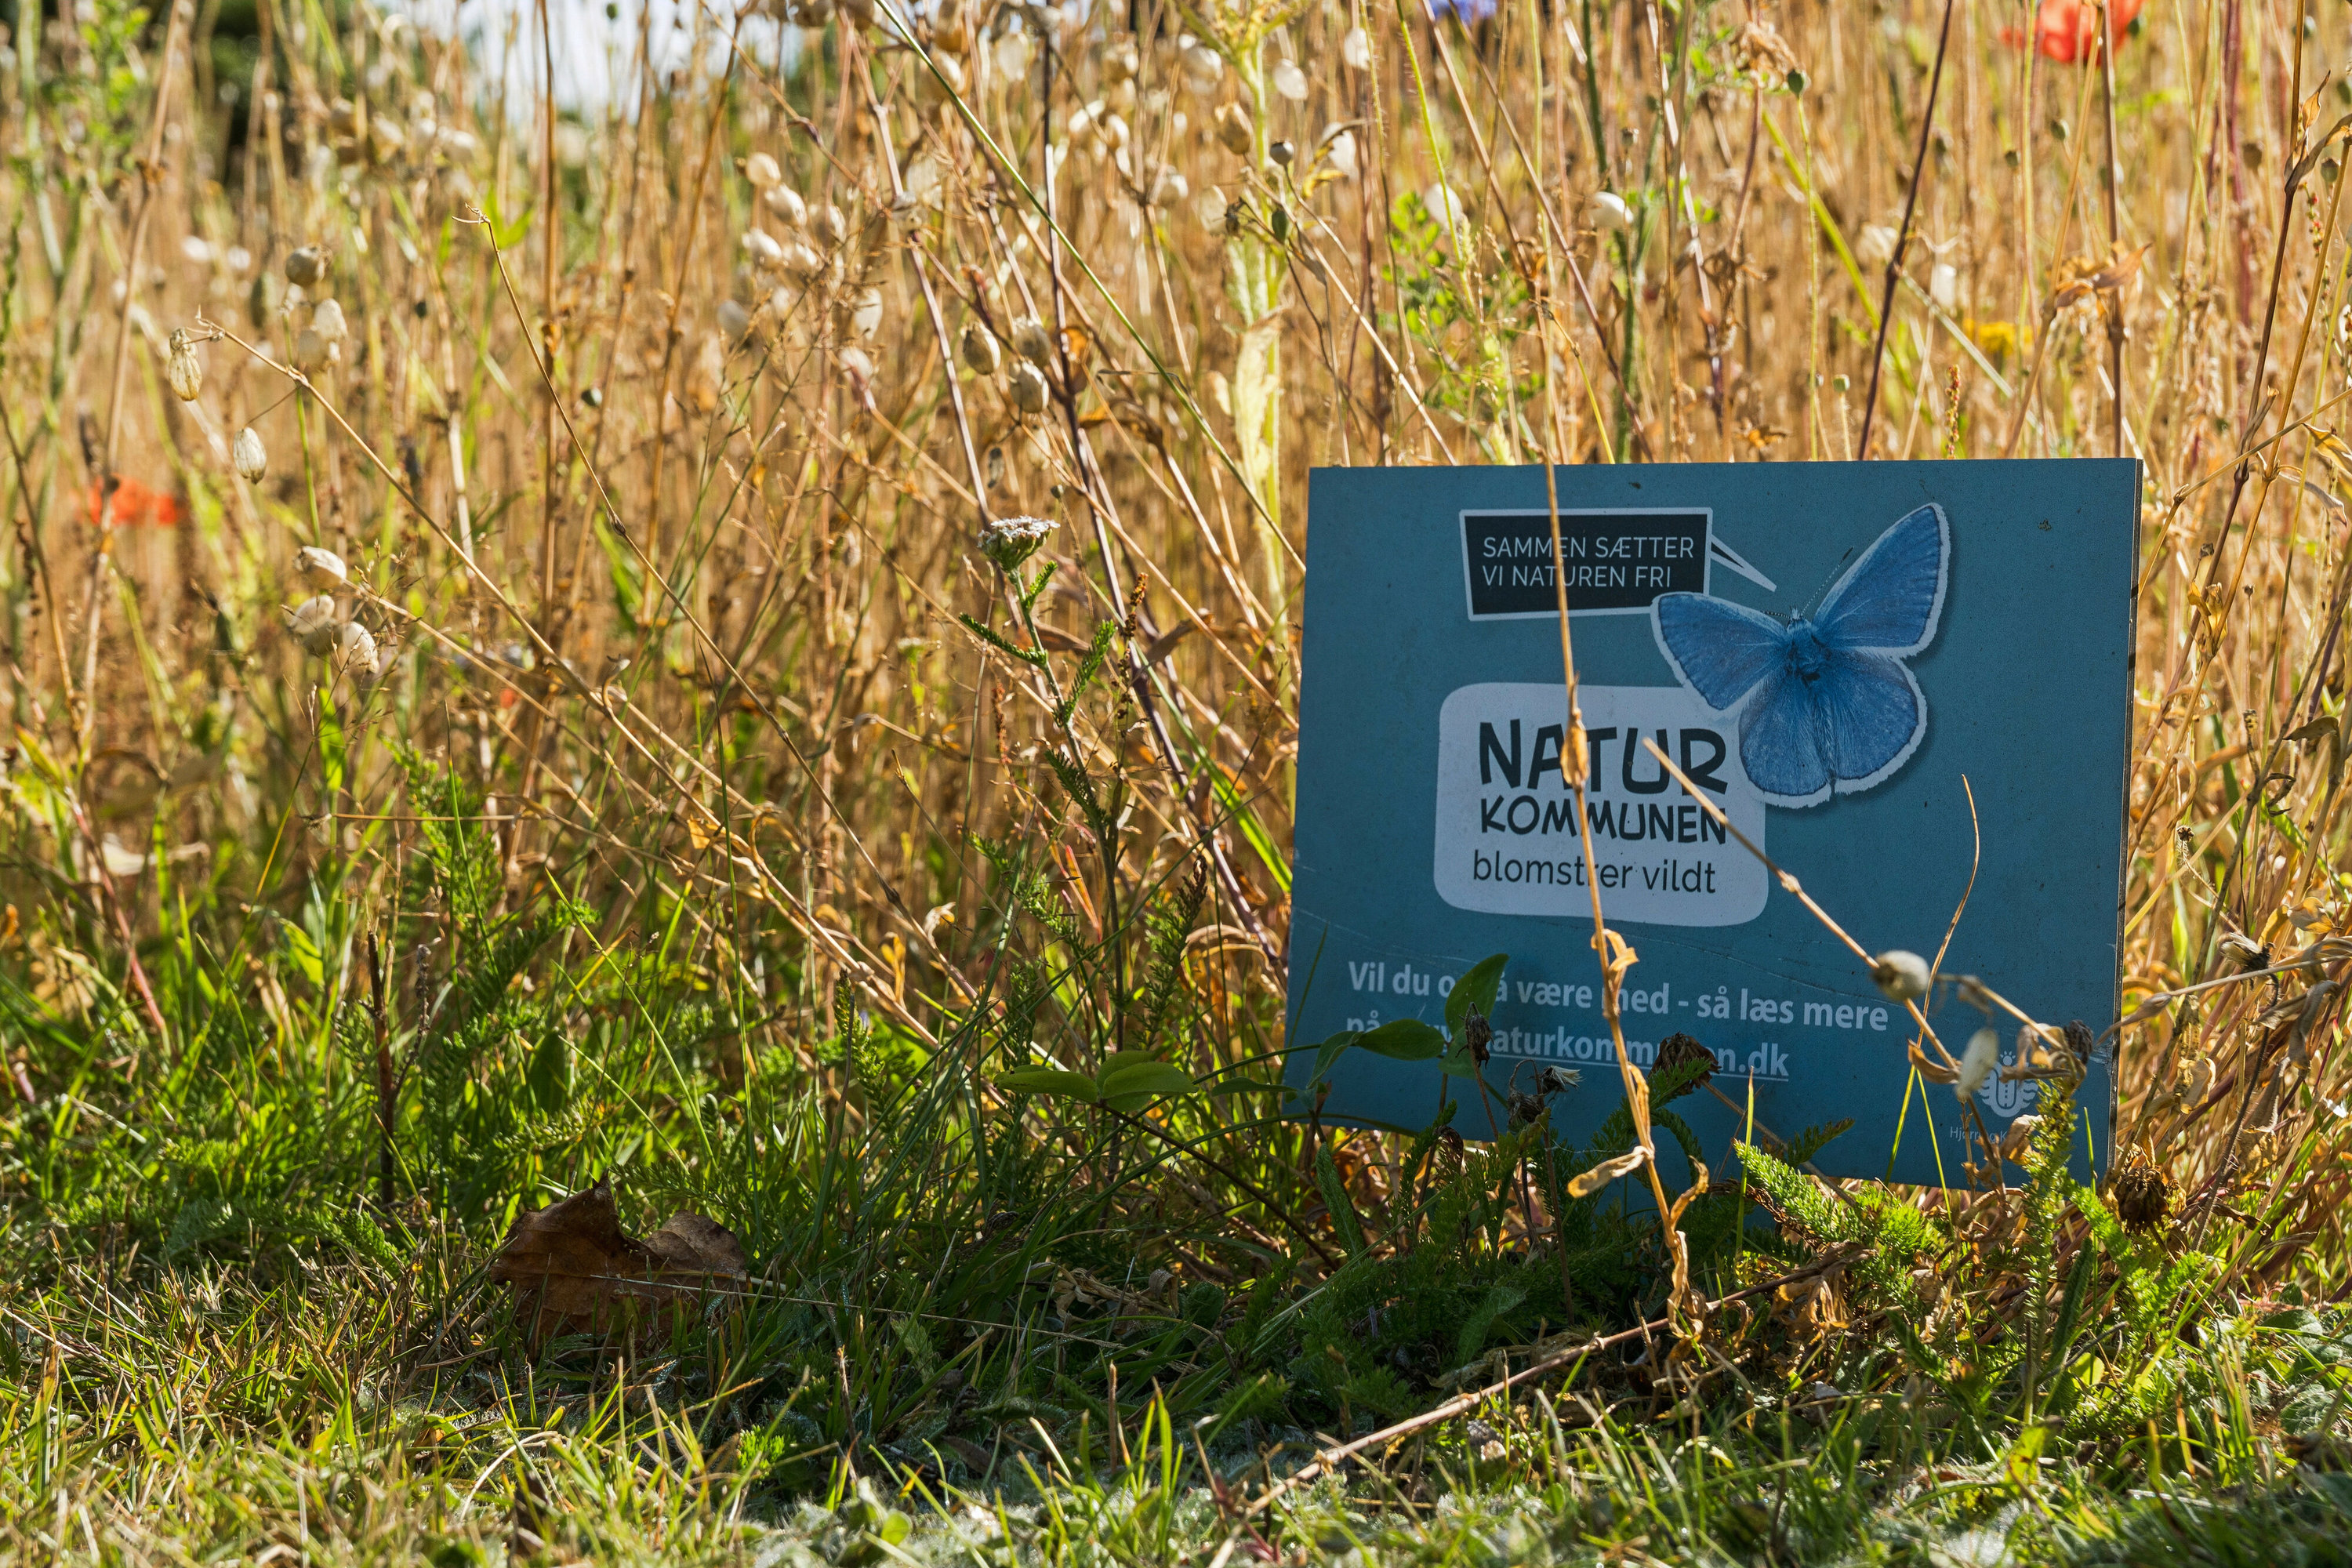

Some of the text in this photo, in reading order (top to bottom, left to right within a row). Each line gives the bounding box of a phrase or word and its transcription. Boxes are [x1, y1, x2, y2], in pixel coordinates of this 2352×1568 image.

[1483, 536, 1694, 559] SAMMEN SÆTTER
[1483, 564, 1671, 588] VI NATUREN FRI
[1479, 718, 1728, 797] NATUR
[1480, 794, 1726, 845] KOMMUNEN
[1642, 858, 1715, 894] vildt
[1348, 960, 1385, 993] Vil
[1392, 964, 1430, 996] du
[1438, 971, 1508, 1003] oå
[1517, 981, 1592, 1008] være
[1697, 985, 1730, 1019] så
[1740, 988, 1795, 1024] læs
[1803, 1001, 1889, 1032] mere
